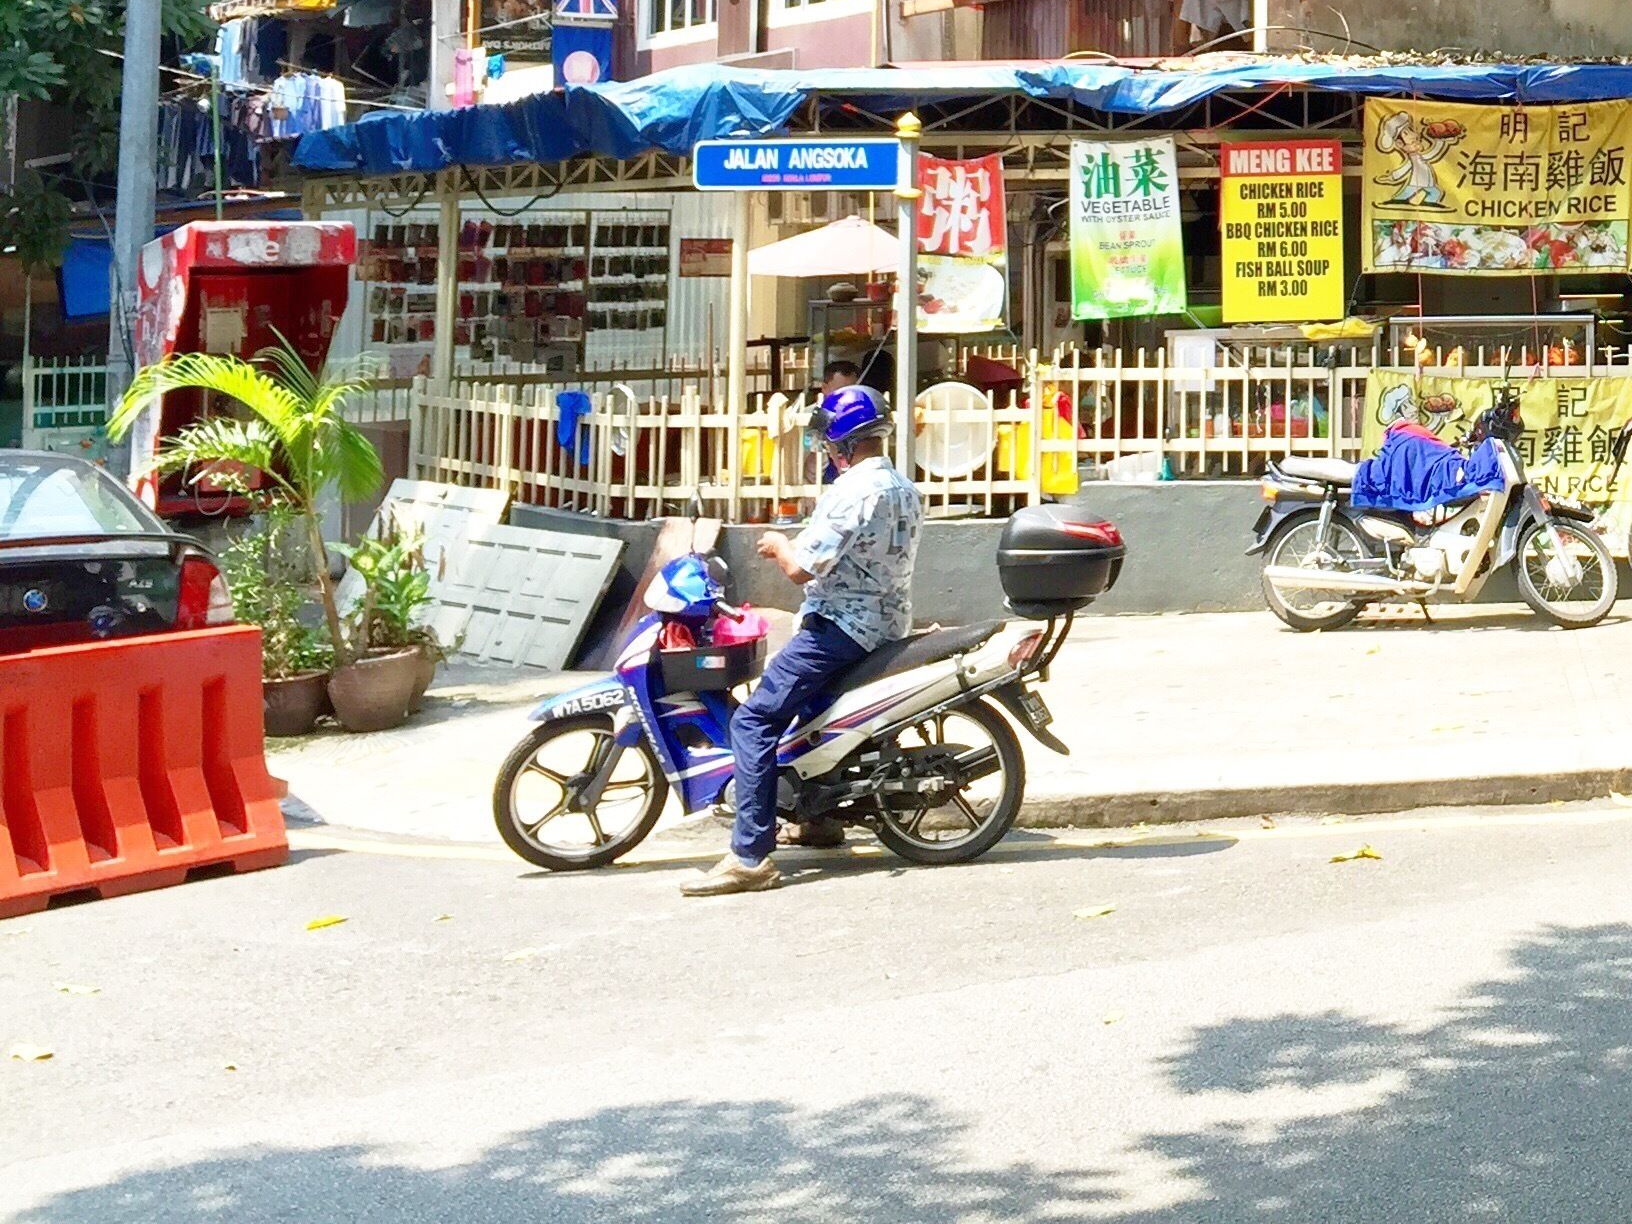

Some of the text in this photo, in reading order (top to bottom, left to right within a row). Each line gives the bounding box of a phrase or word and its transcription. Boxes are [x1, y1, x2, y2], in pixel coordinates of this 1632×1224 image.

[1500, 110, 1590, 144] 明記
[723, 147, 868, 170] JALAN ANGSOKA
[1229, 148, 1333, 174] MENG KEE
[1081, 147, 1170, 200] 油菜
[1456, 146, 1626, 192] 海南雞飯
[1240, 182, 1324, 200] CHICKEN RICE
[1081, 196, 1171, 215] VEGETABLE
[1257, 202, 1307, 218] RM 5.00
[1464, 194, 1617, 218] CHICKEN RICE
[1081, 214, 1103, 223] WITH
[1106, 212, 1140, 223] OYSTER
[1226, 220, 1339, 240] BBQ CHICKEN RICE
[1258, 241, 1307, 257] RM 6.00
[1236, 260, 1330, 278] FISH BALL SOUP
[1258, 280, 1308, 297] RM 3.00
